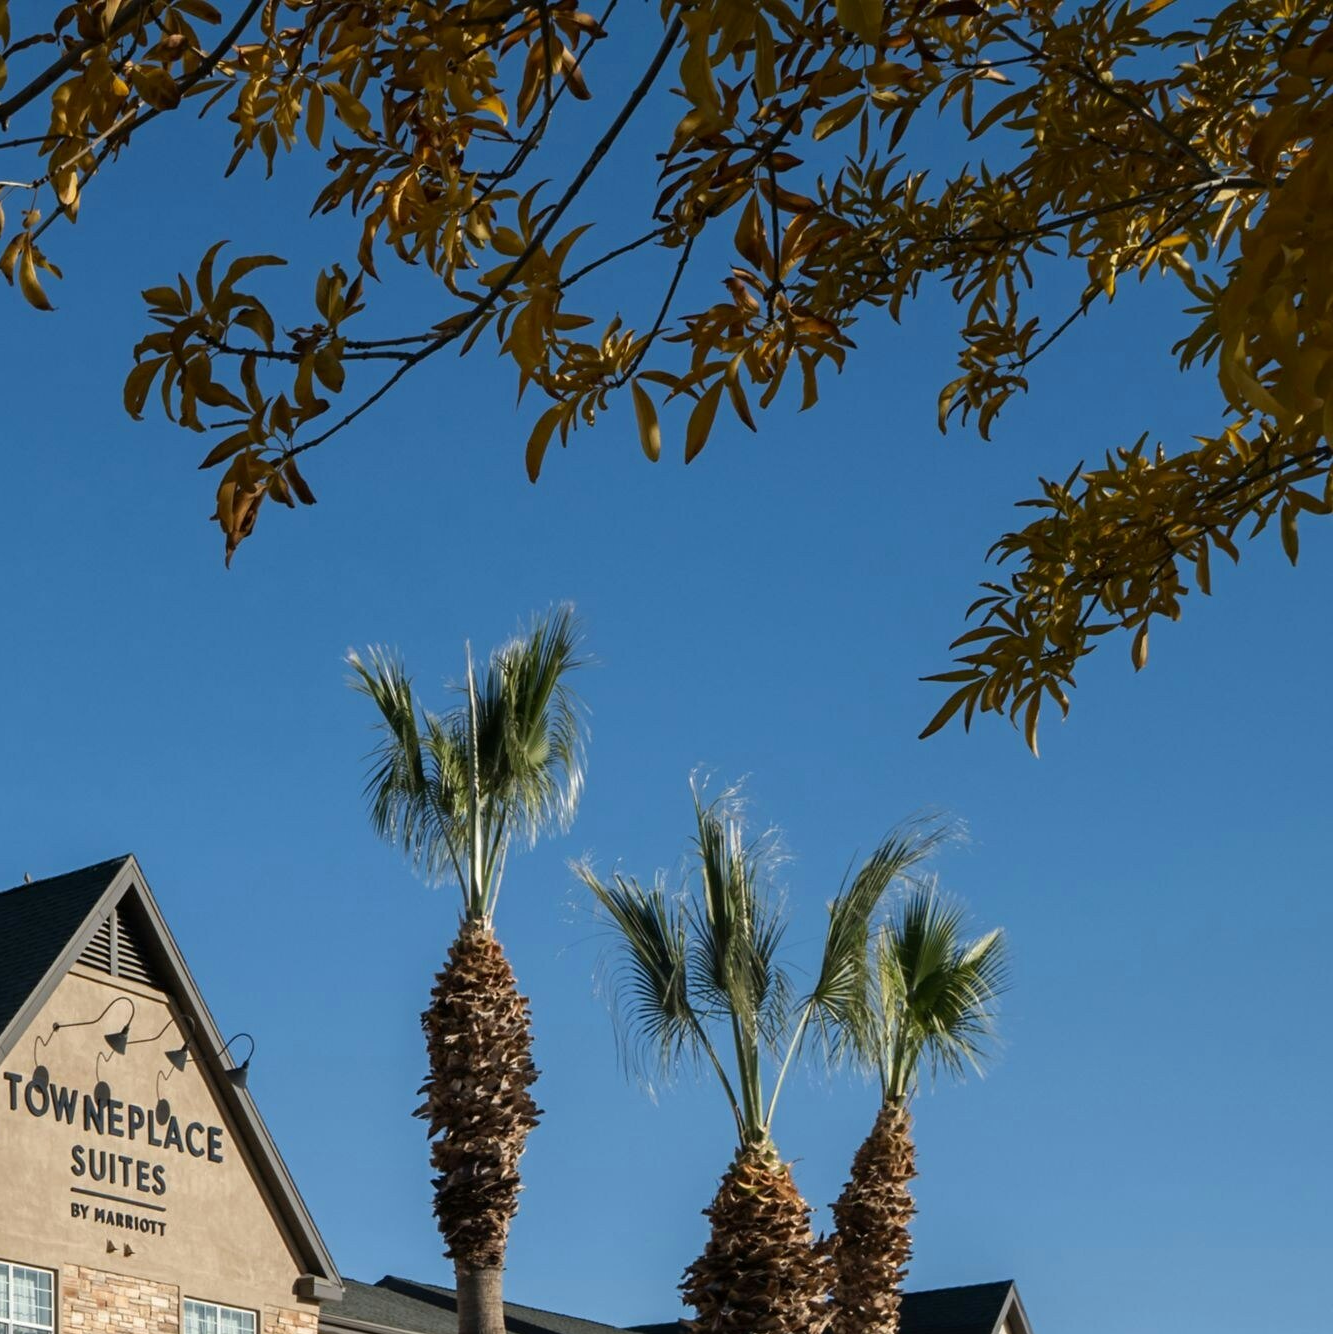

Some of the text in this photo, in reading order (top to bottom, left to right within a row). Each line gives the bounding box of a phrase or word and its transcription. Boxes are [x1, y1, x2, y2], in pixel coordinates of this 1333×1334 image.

[4, 1071, 224, 1163] TOWNEPLACE
[70, 1144, 166, 1196] SUITES
[71, 1202, 167, 1236] BY MARRIOTT
